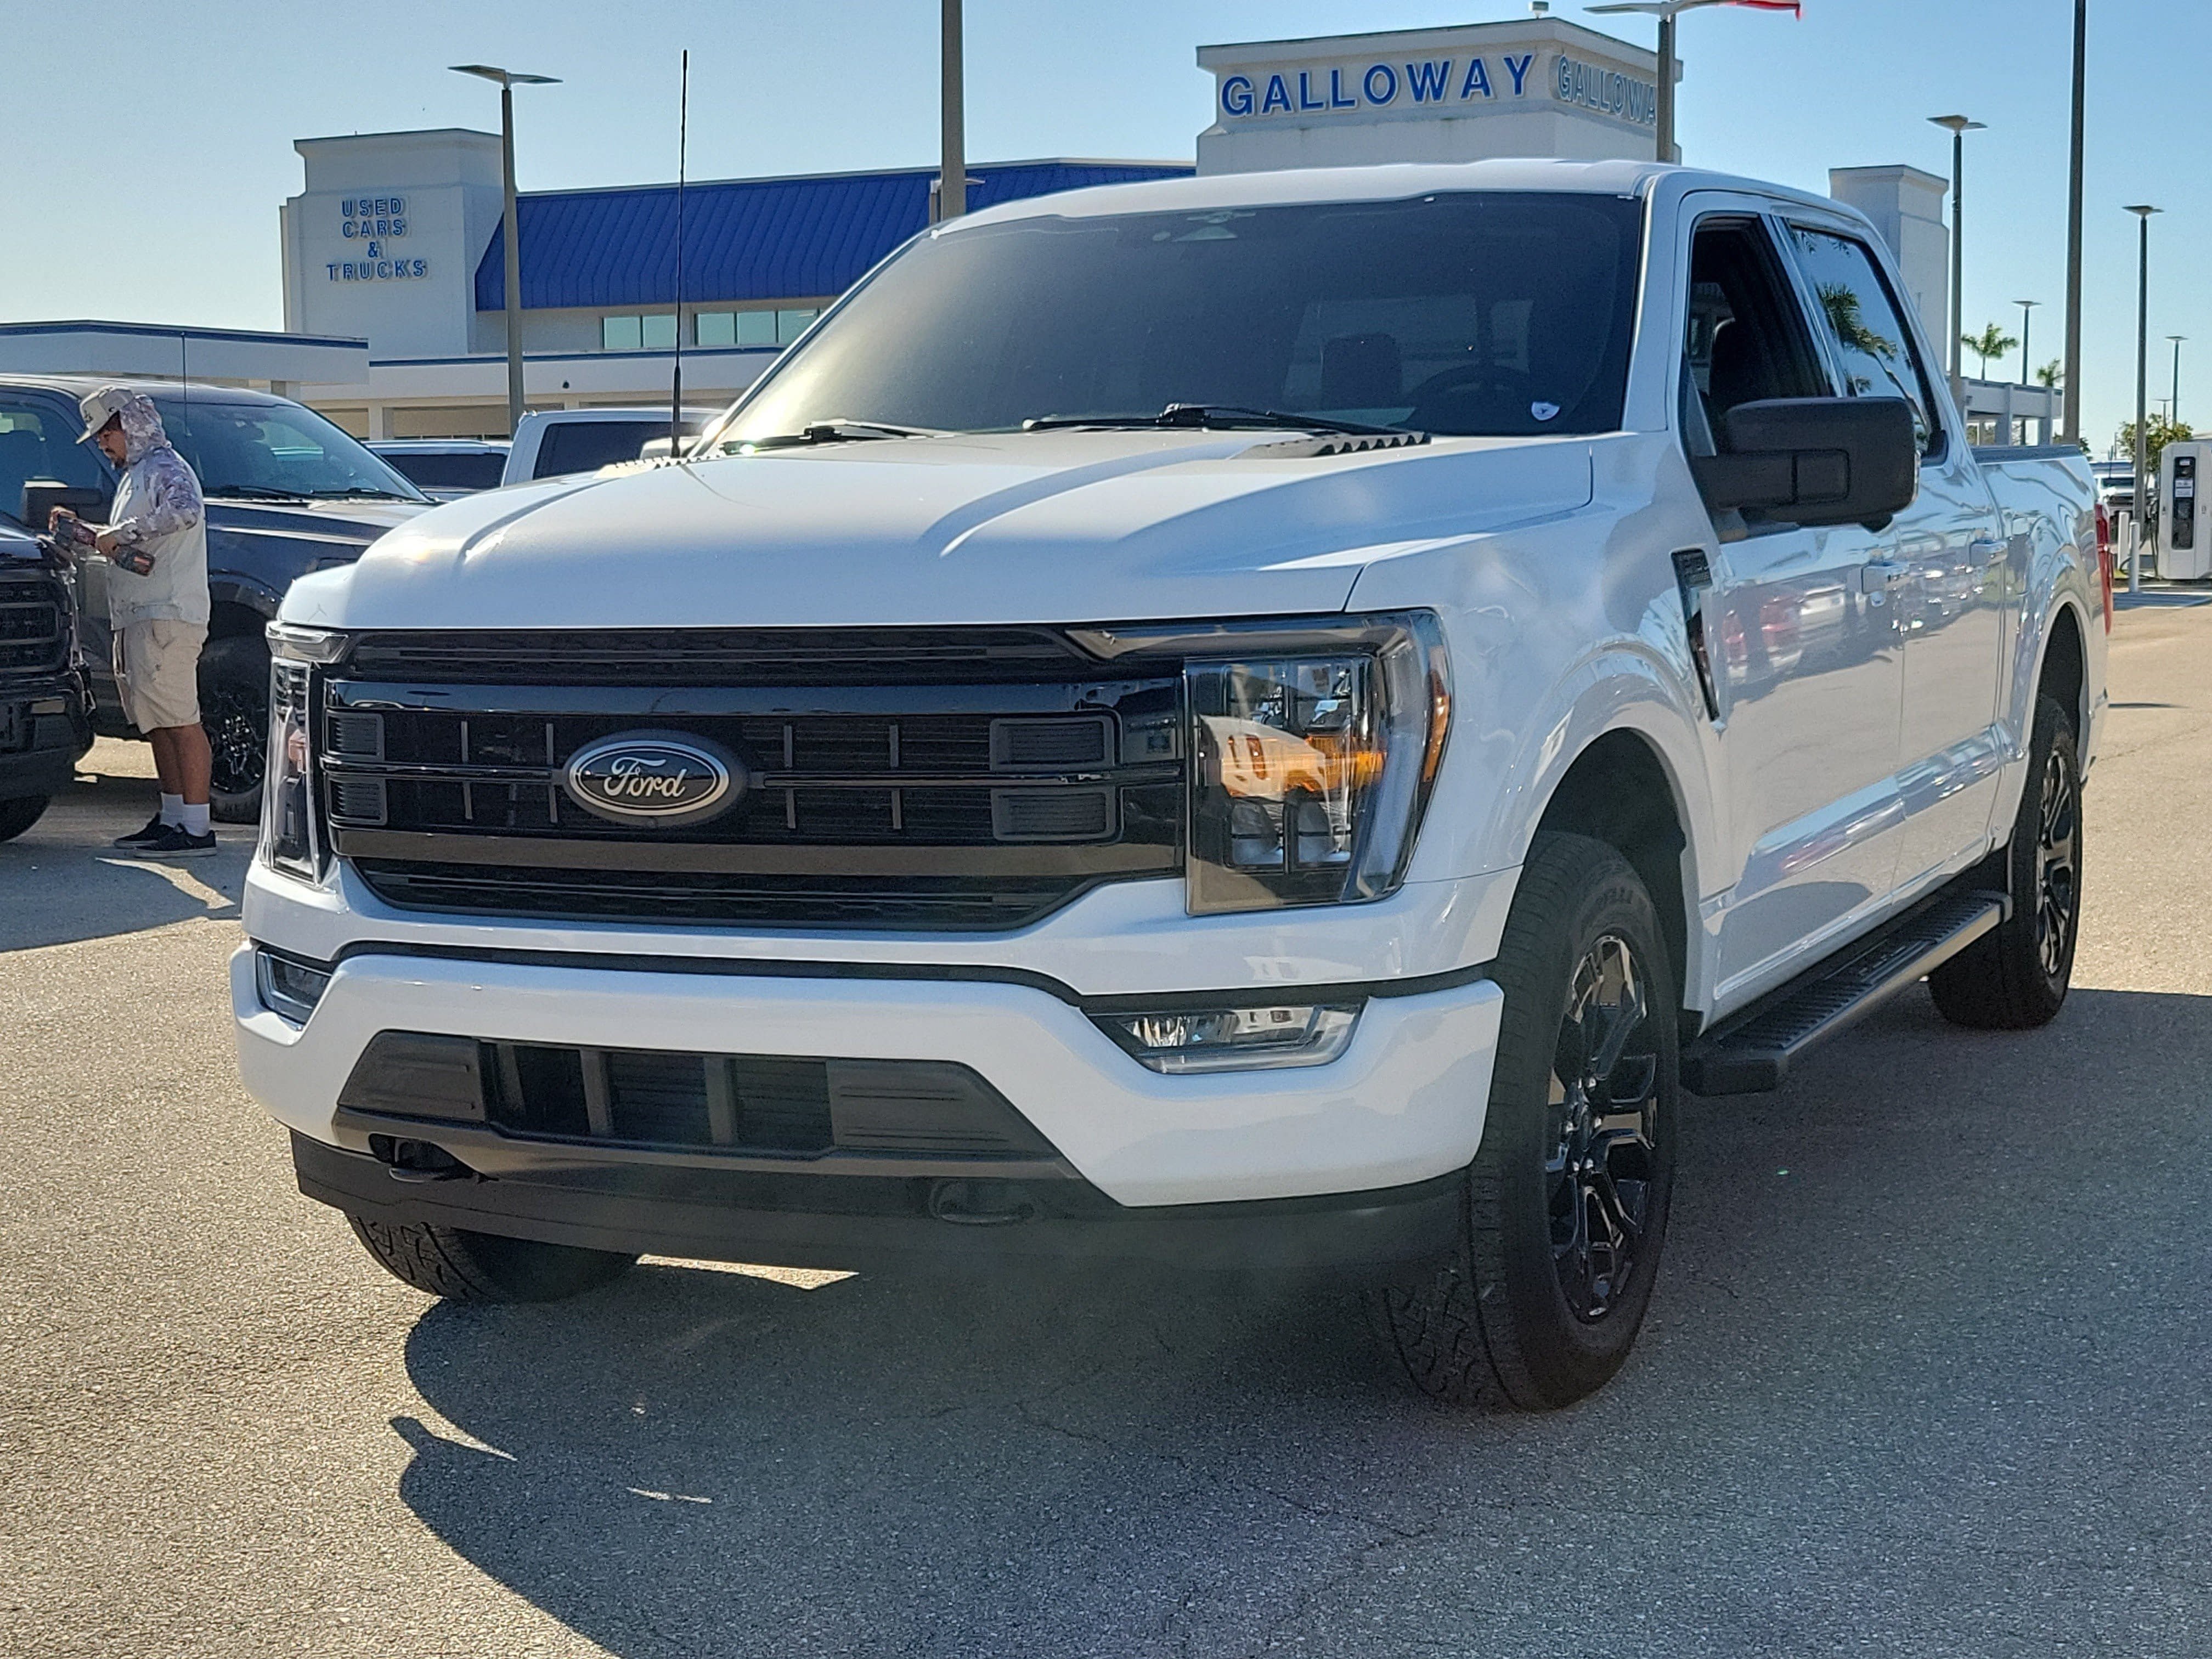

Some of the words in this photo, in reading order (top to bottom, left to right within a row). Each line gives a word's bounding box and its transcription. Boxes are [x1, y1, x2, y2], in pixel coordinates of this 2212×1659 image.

[1221, 54, 1533, 117] GALLOWAY
[1558, 54, 1658, 126] GALLOWA
[341, 198, 403, 217] USED
[342, 219, 405, 238] CARS
[368, 241, 379, 257] &
[326, 260, 425, 281] TRUCKS
[603, 757, 687, 797] Ford
